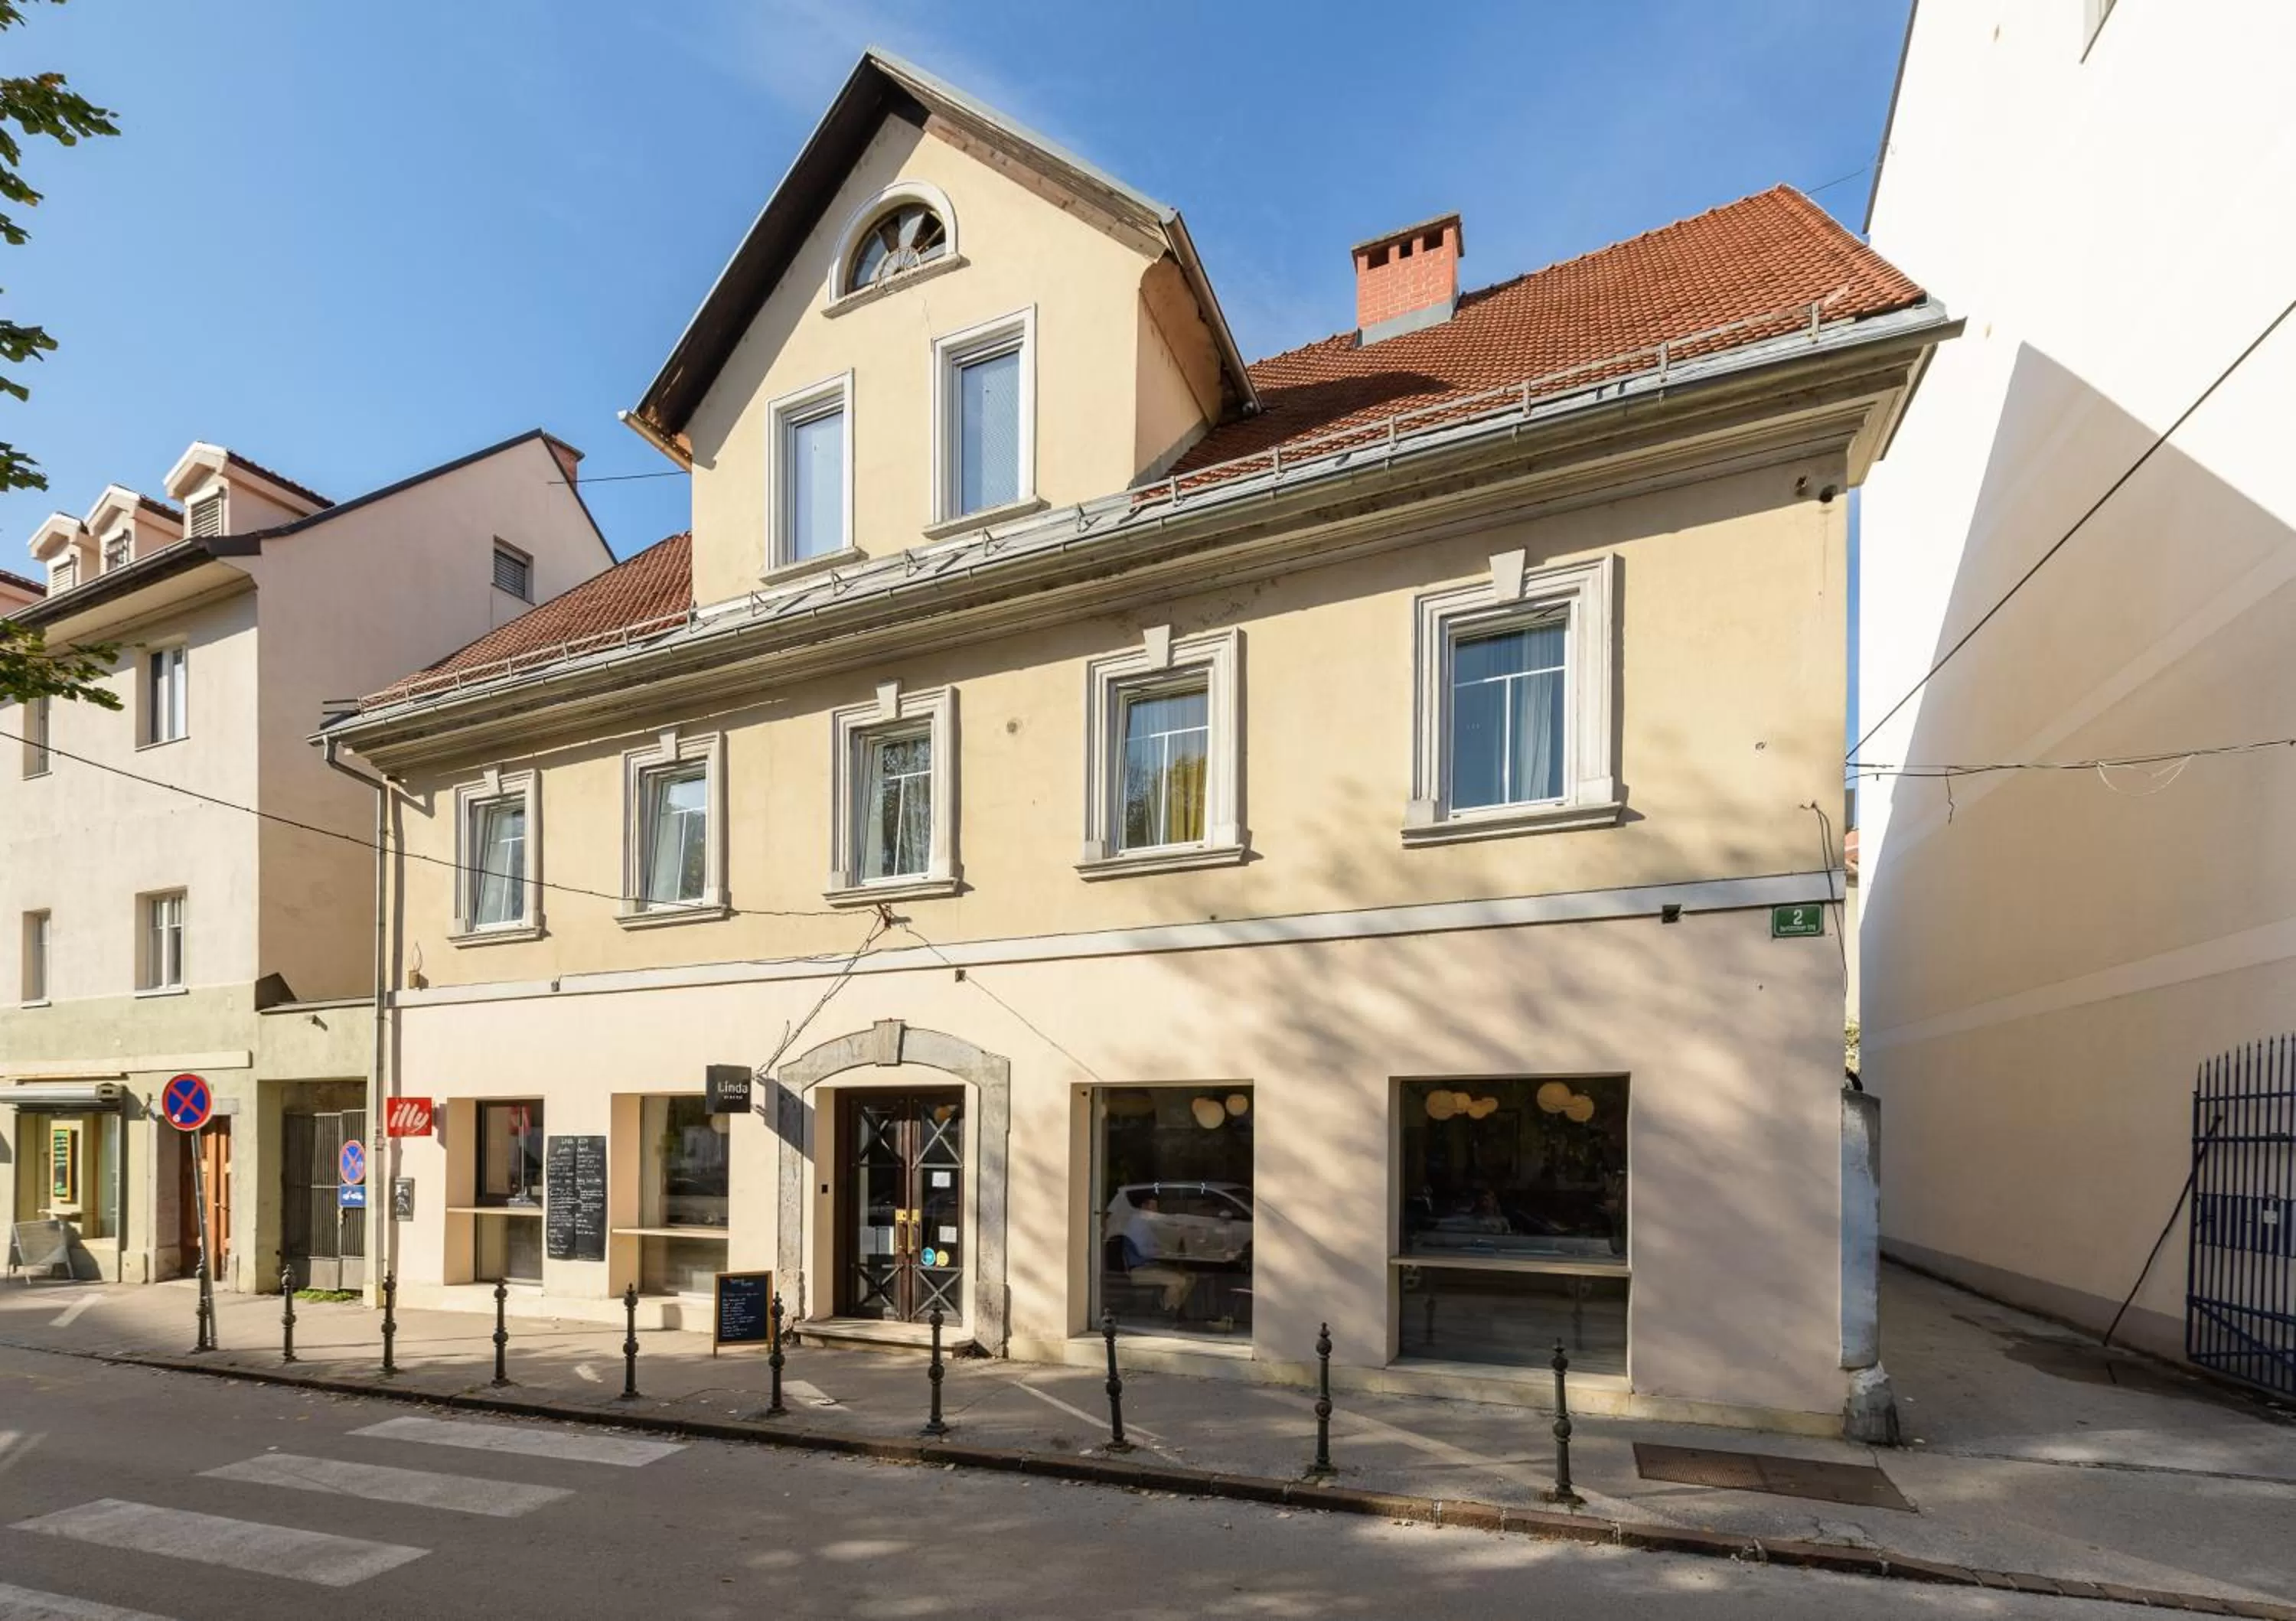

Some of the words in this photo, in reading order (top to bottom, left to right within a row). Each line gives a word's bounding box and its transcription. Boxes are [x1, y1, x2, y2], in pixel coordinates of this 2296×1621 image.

[1793, 908, 1802, 925] 2
[717, 1080, 748, 1094] Linda
[390, 1103, 429, 1133] illy
